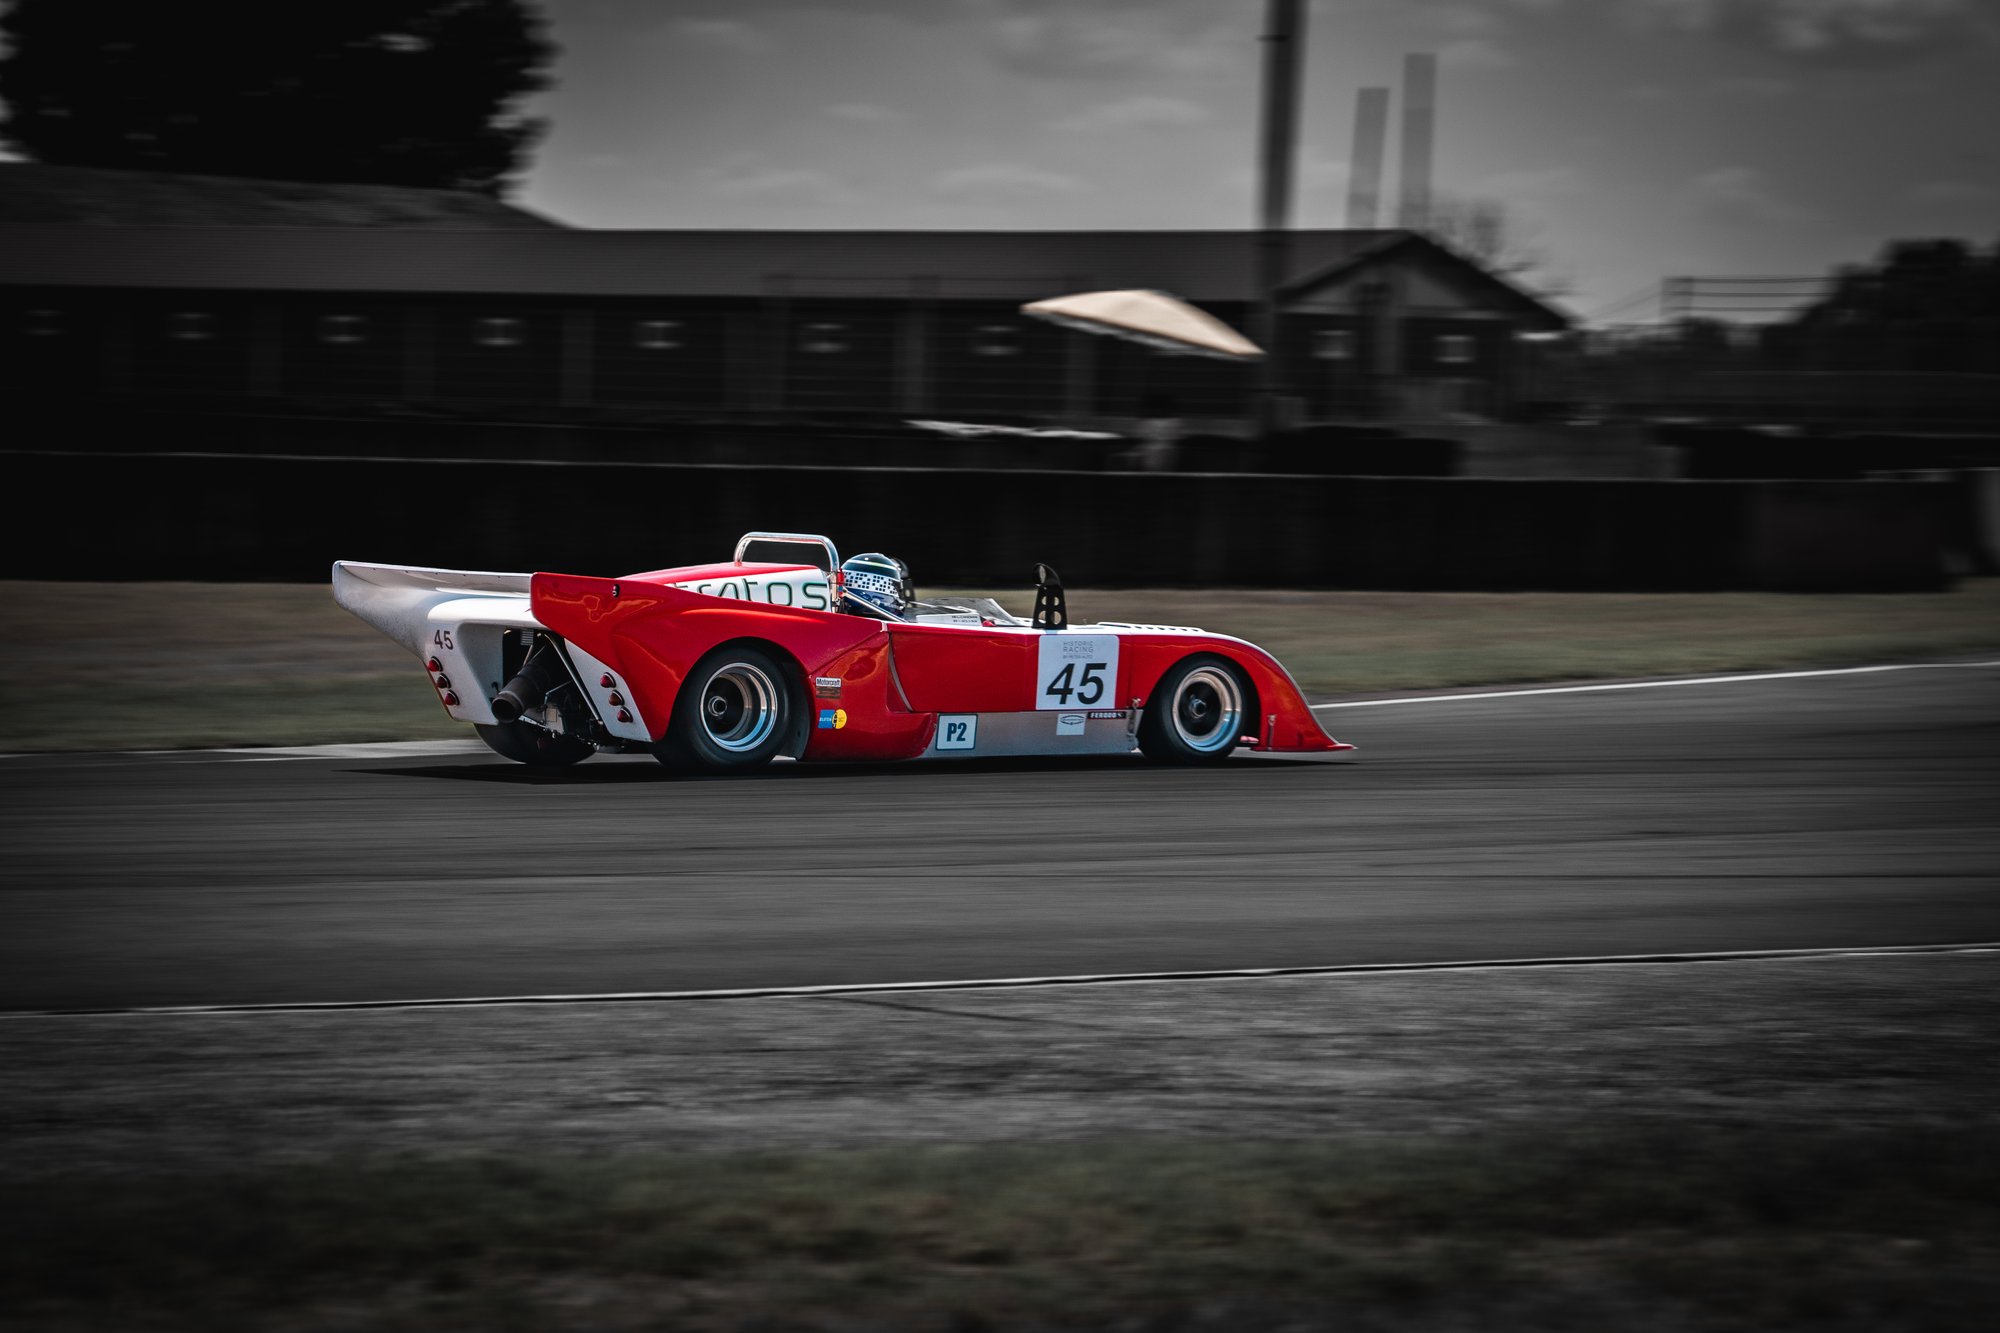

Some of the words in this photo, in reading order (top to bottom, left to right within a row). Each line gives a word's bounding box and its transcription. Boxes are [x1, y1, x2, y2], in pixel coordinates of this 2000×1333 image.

[434, 629, 453, 650] 45
[1046, 663, 1107, 705] 45
[947, 722, 967, 742] P2
